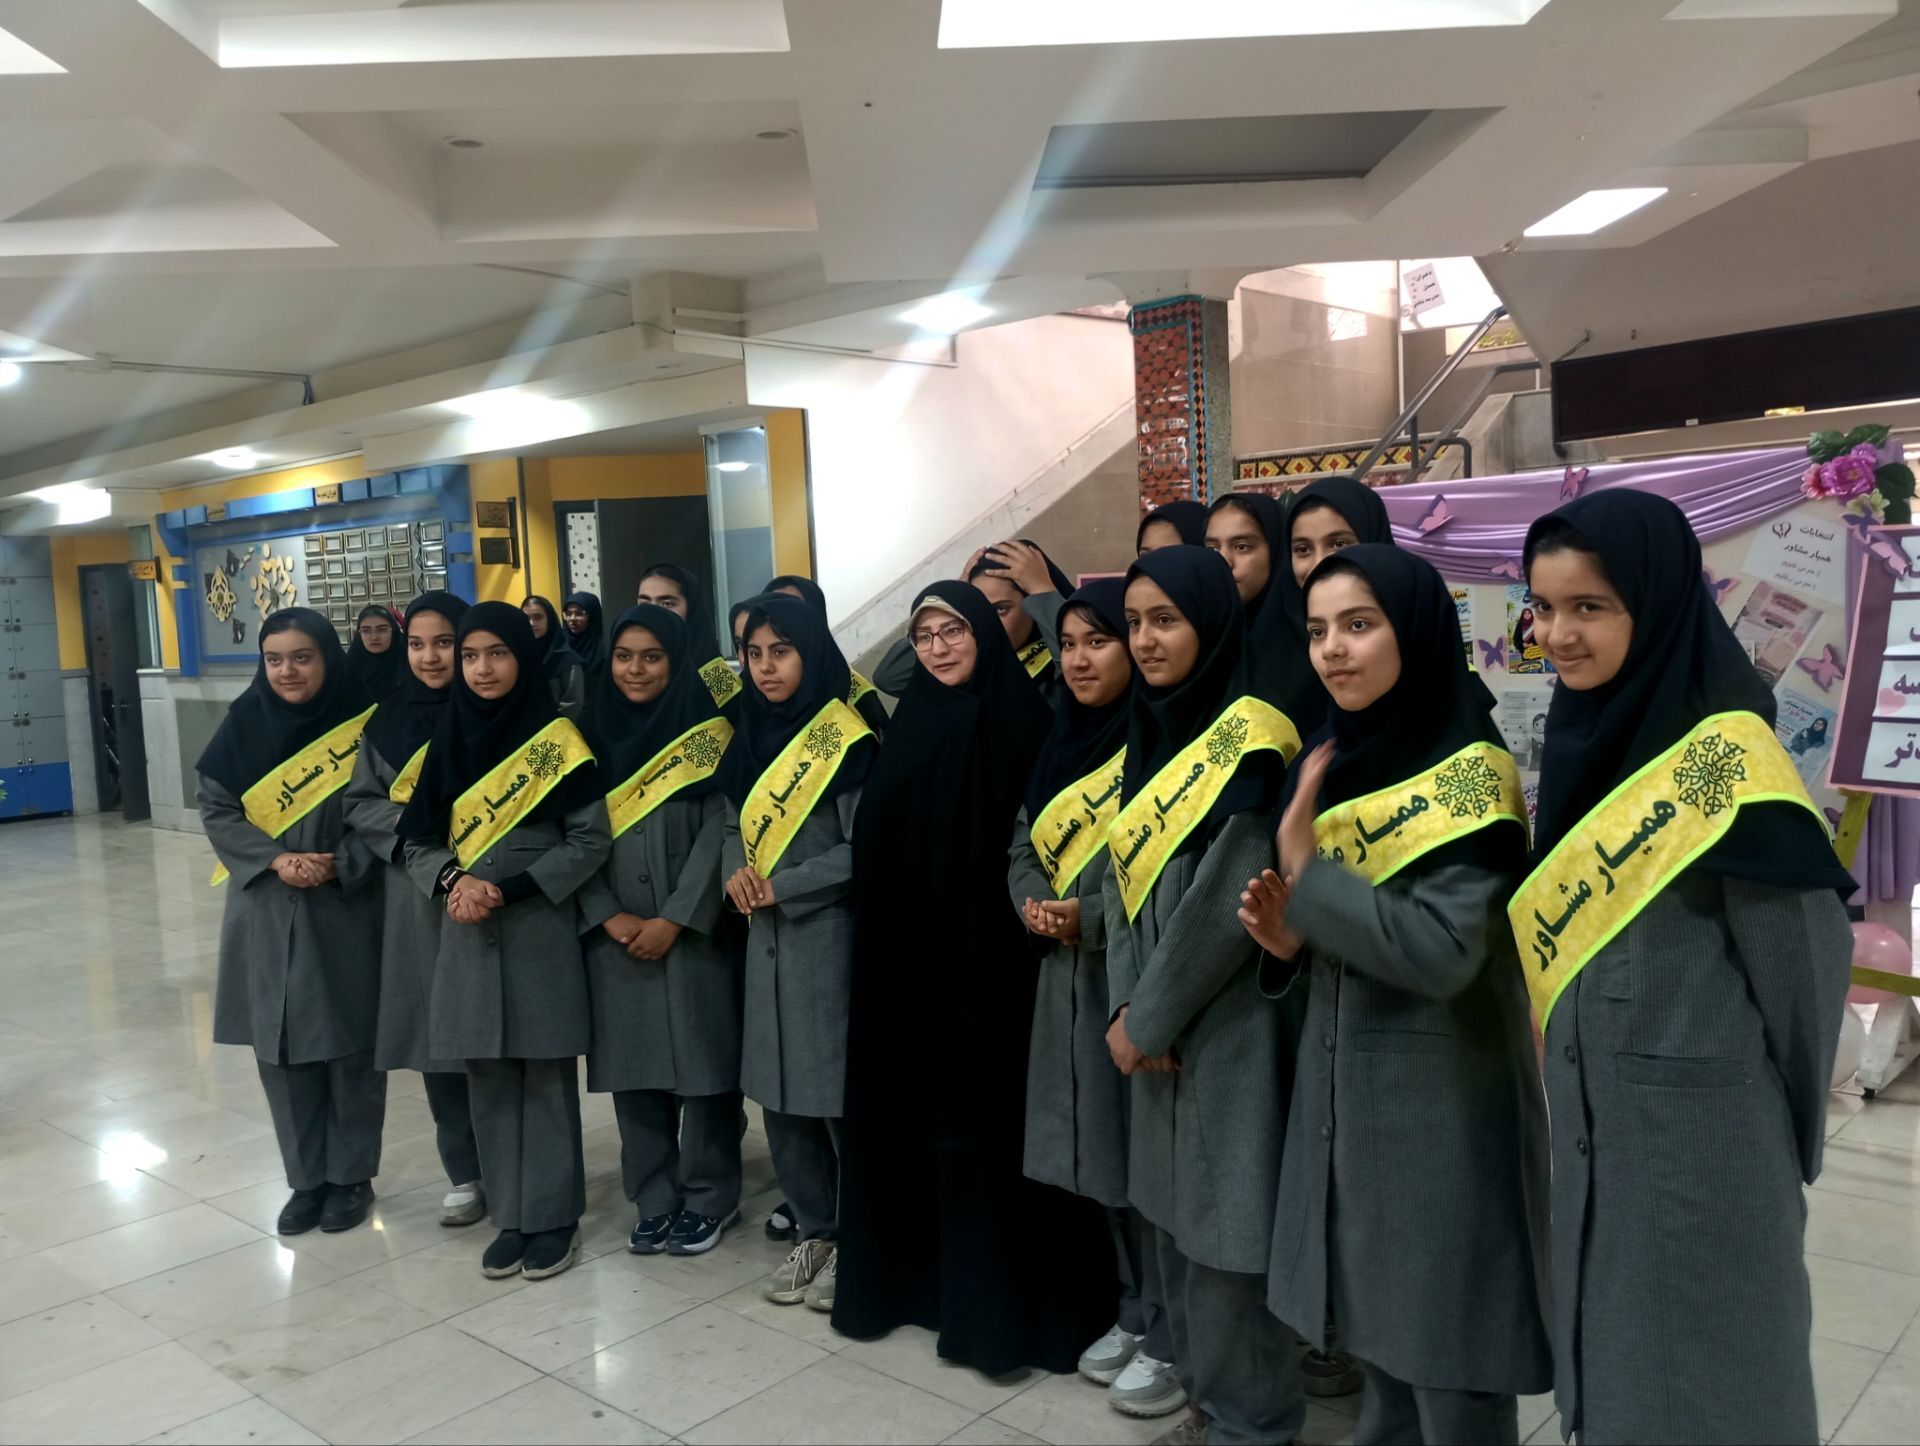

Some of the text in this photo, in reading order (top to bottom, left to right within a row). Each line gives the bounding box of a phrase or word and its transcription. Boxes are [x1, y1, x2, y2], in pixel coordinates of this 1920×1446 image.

[1783, 543, 1832, 563] همیار مشاور
[1799, 526, 1834, 542] انتخابات
[276, 732, 362, 812] میار مشاور
[483, 774, 530, 824] همیار
[769, 761, 812, 819] همیار
[1082, 765, 1124, 827] میار
[1113, 762, 1205, 894] همیار مشاور
[1355, 794, 1430, 865] همیار
[1532, 800, 1677, 972] همیار مشاور
